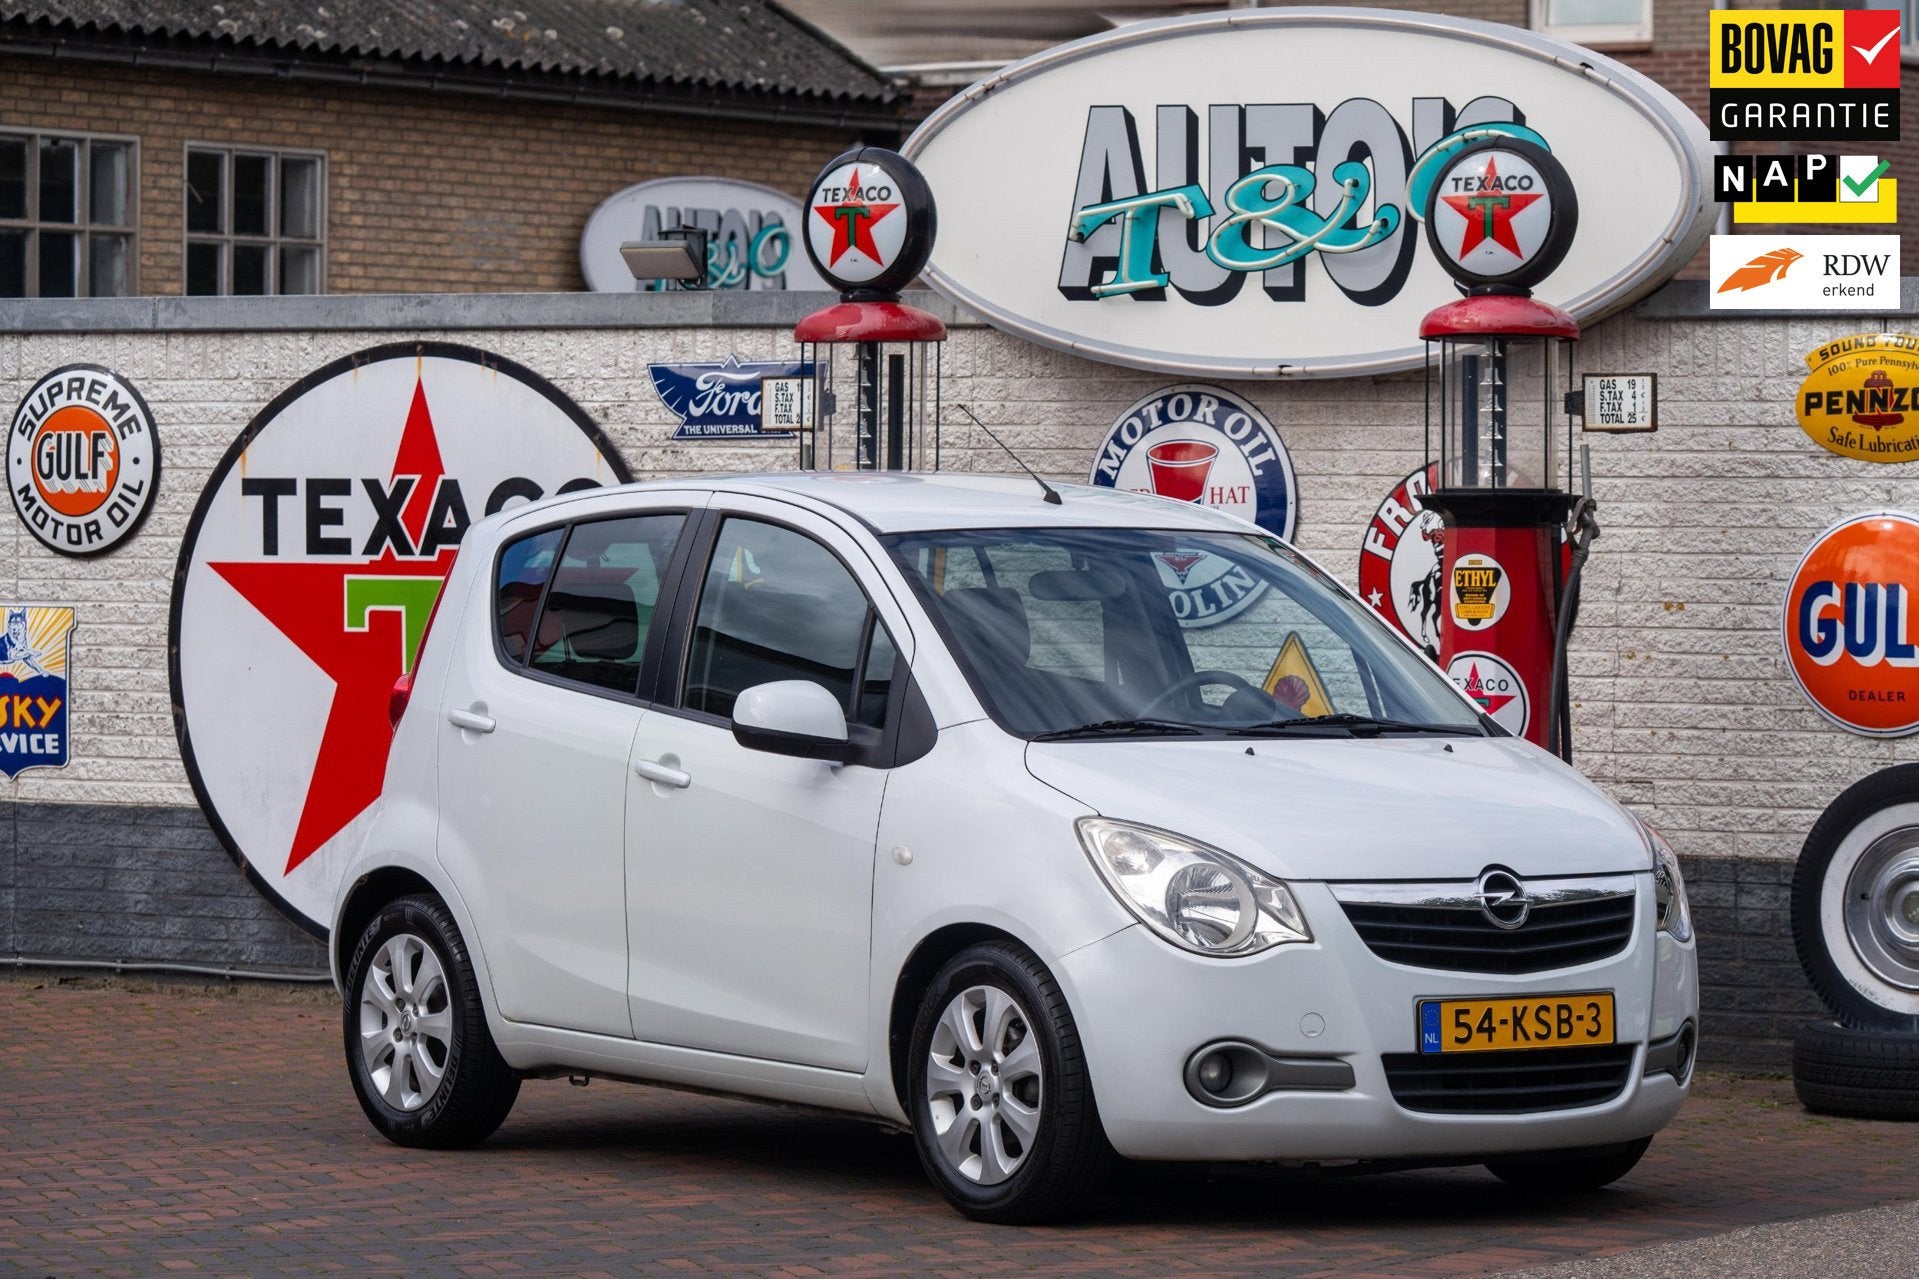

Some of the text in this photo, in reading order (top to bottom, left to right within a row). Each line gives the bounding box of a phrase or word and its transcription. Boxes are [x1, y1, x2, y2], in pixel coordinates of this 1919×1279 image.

[1452, 174, 1534, 192] TEXACO
[822, 185, 892, 203] TEXACO
[1057, 96, 1527, 306] AUTO'
[1819, 335, 1919, 361] SOUND YOU
[1855, 357, 1877, 368] Pure
[775, 382, 789, 392] GAS
[1599, 379, 1617, 390] GAS
[1627, 379, 1636, 389] 19
[775, 392, 794, 403] S.TAX
[1599, 391, 1624, 402] S.TAX
[1631, 391, 1637, 401] 4
[17, 377, 142, 442] SUPREME
[774, 403, 793, 414] F.TAX
[1599, 402, 1623, 413] F.TAX
[774, 414, 794, 424] TOTAL
[1599, 413, 1625, 424] TOTAL
[1627, 413, 1637, 424] 25
[684, 424, 702, 435] THE
[703, 424, 758, 435] UNIVERSAL
[1097, 393, 1276, 480] MOTOR OIL
[1827, 426, 1857, 449] Safe
[37, 432, 107, 480] GULF
[1210, 486, 1250, 505] HAT
[17, 480, 145, 546] MOTOR OIL
[242, 477, 604, 556] TEXA
[1455, 570, 1497, 587] ETHYL
[1848, 690, 1906, 702] DEALER
[1453, 1002, 1602, 1044] 54-KSB-3
[1425, 1033, 1440, 1044] NL
